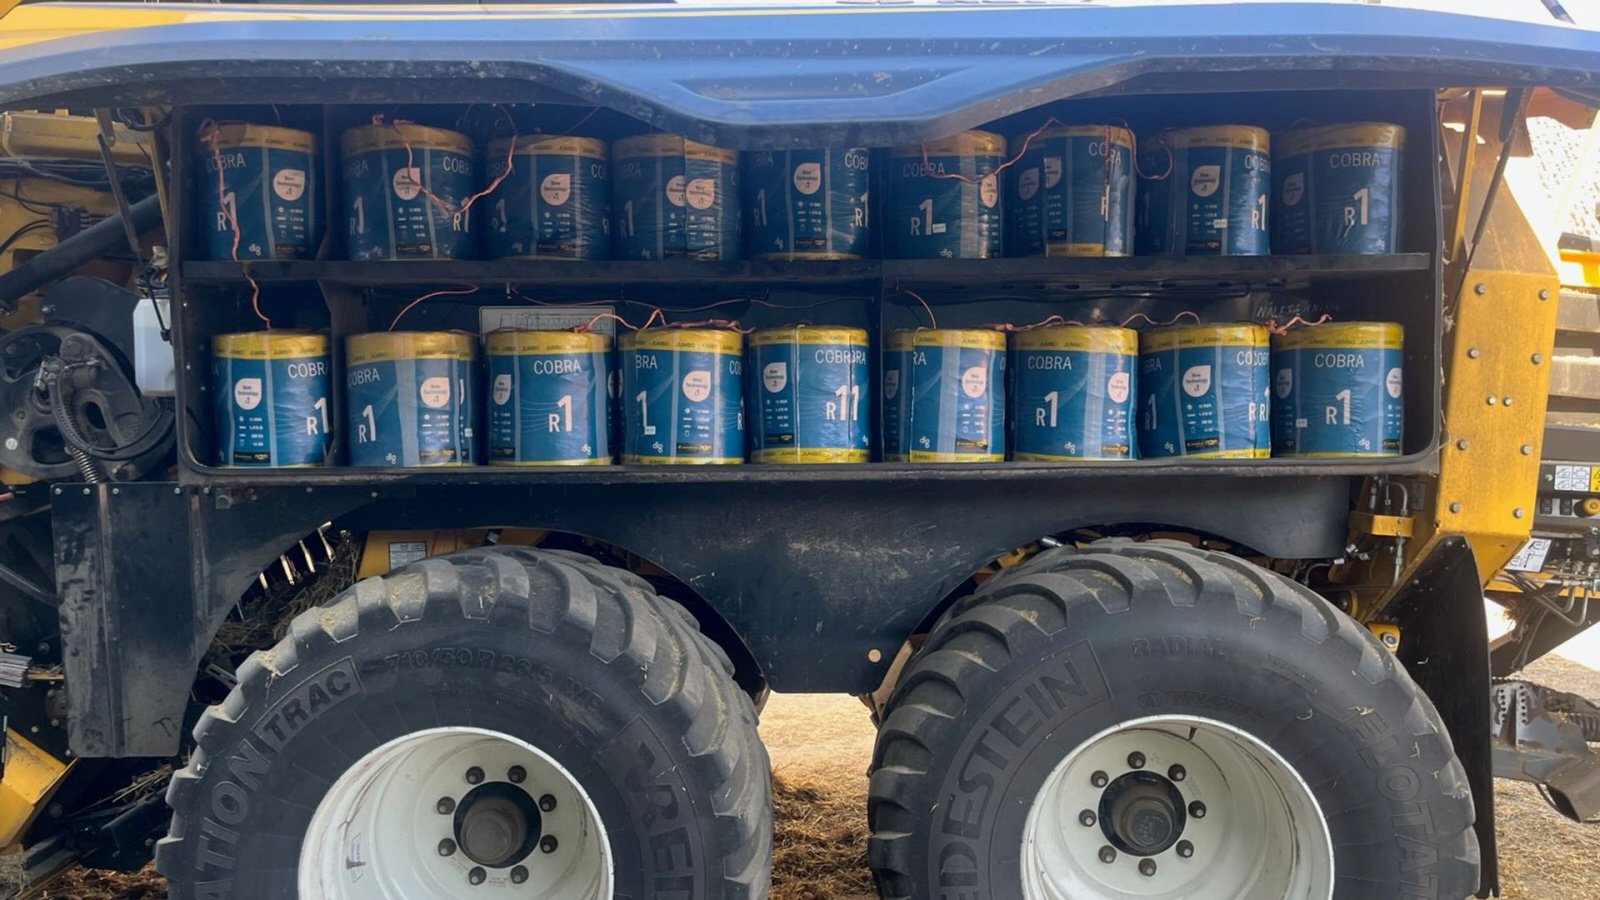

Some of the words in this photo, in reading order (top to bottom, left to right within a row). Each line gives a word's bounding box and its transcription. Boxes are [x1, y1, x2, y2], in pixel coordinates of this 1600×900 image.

[1329, 152, 1381, 168] COBRA
[910, 198, 934, 236] R1
[1251, 193, 1267, 231] R1
[1344, 187, 1369, 226] R1
[533, 359, 582, 375] COBRA
[1027, 355, 1072, 370] COBRA
[1314, 353, 1365, 368] COBRA
[306, 397, 329, 436] R1
[359, 404, 376, 443] R1
[548, 394, 572, 432] R1
[1036, 391, 1058, 427] R1
[1325, 389, 1351, 425] R1
[263, 670, 351, 742] TRAC
[938, 660, 1089, 900] DESTEIN
